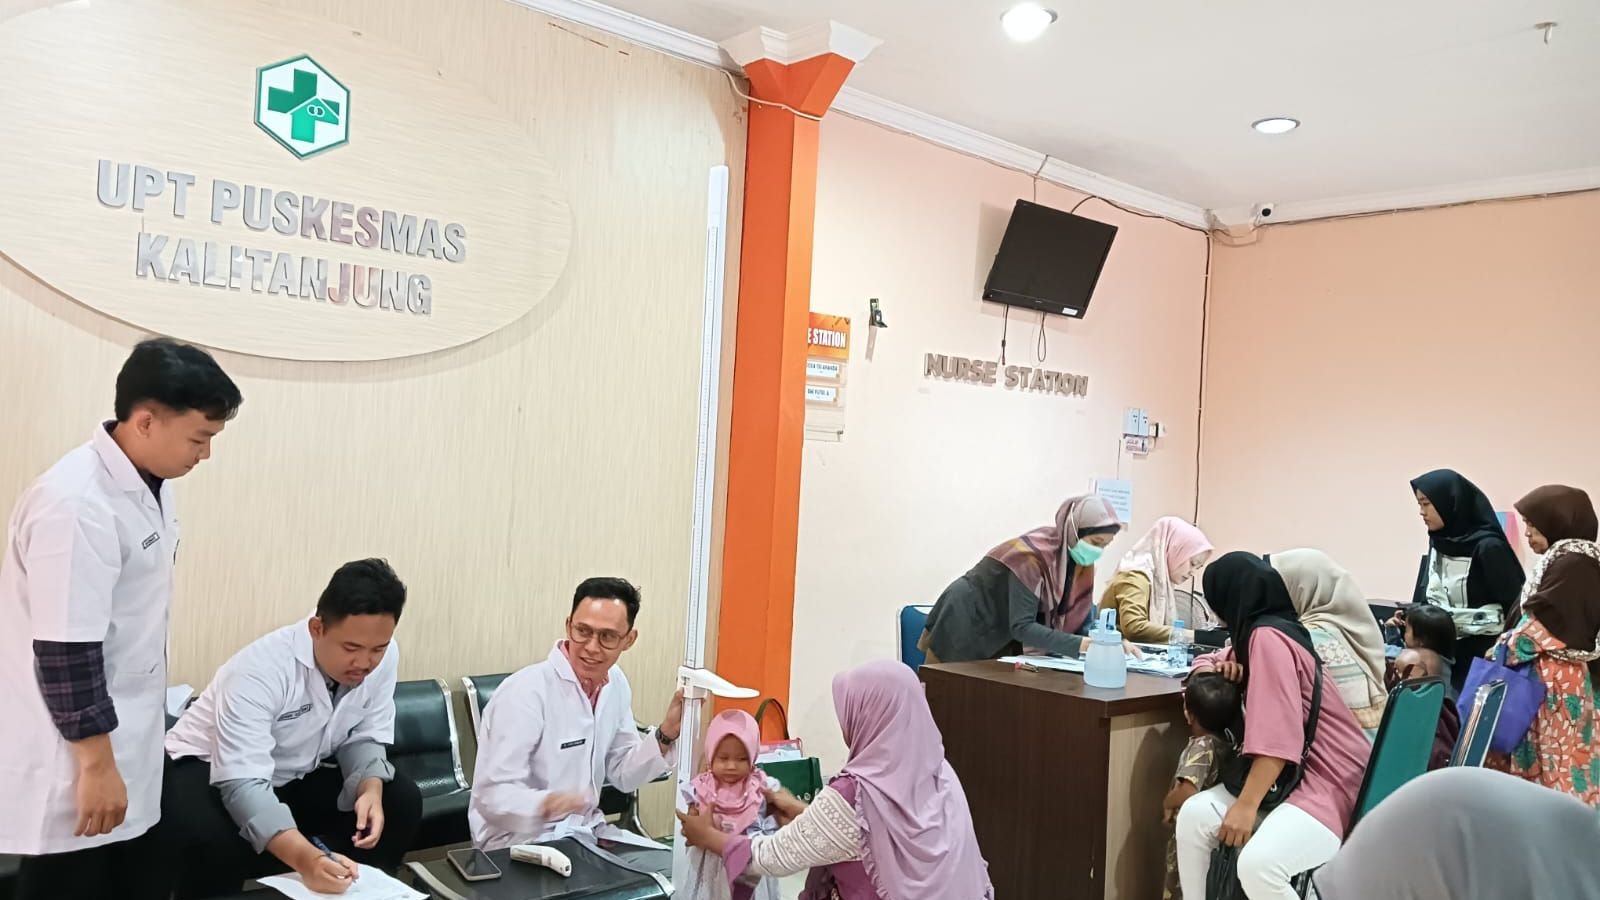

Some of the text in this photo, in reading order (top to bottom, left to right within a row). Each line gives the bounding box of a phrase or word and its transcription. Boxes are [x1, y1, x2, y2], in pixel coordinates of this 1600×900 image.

[96, 159, 467, 263] UPT PUSKESMAS
[136, 231, 432, 315] KALITANJUNG
[813, 327, 847, 349] STATION
[924, 352, 1089, 397] NURSE STATION
